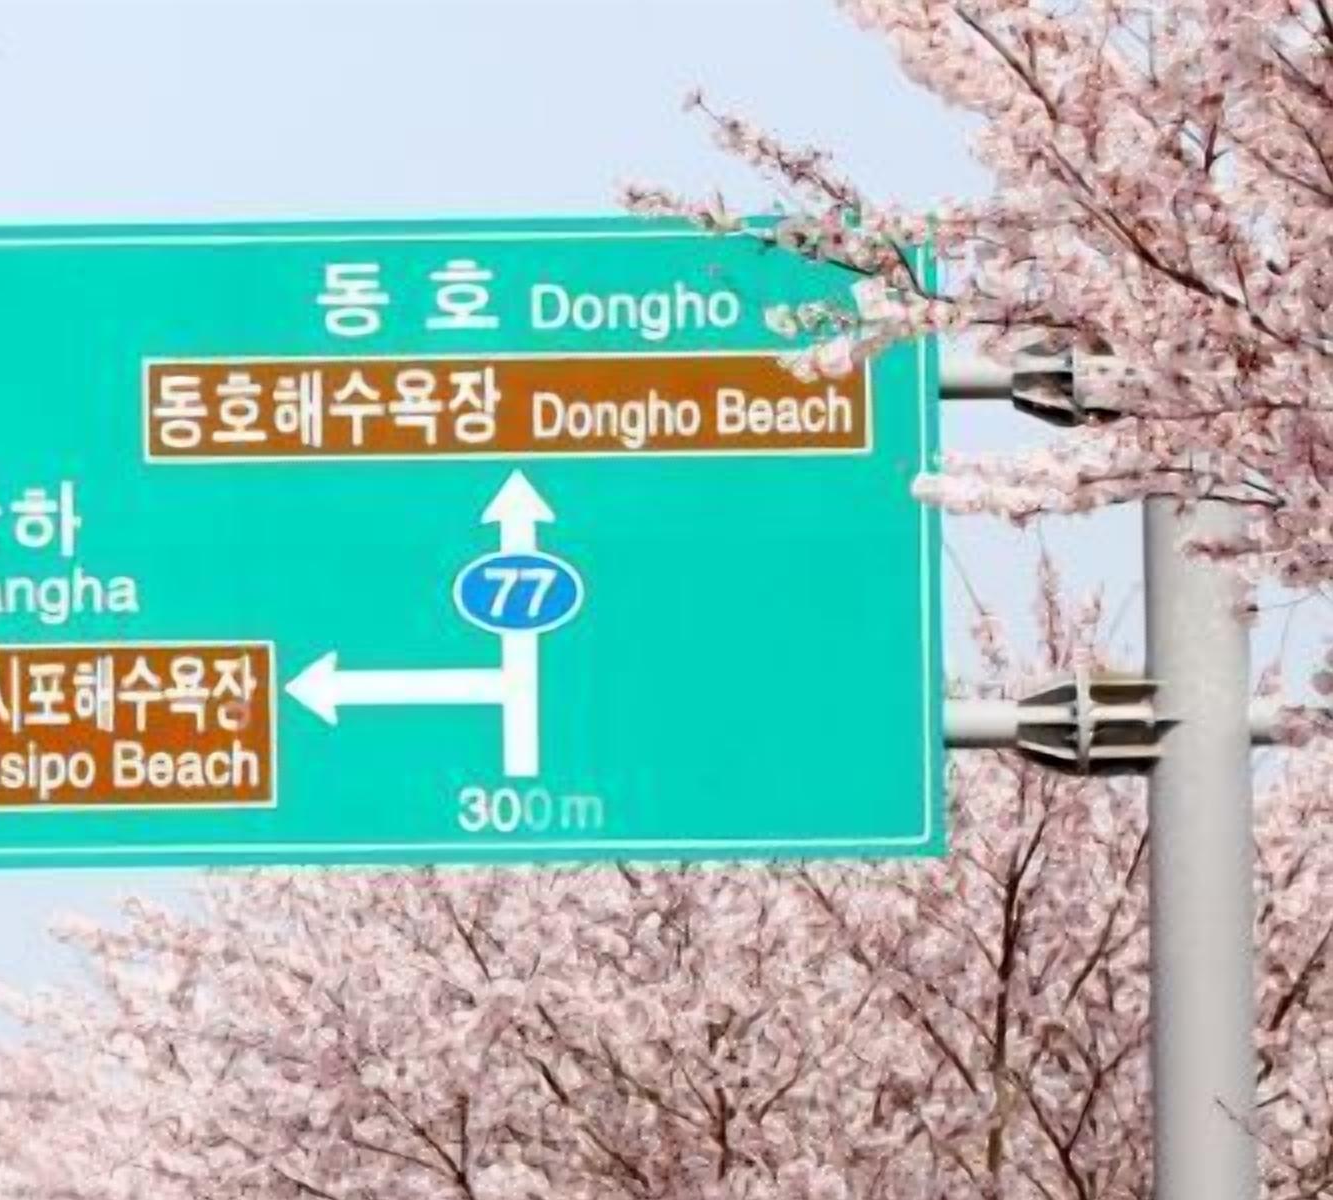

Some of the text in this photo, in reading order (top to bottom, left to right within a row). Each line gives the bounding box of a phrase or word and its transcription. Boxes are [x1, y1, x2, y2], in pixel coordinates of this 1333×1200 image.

[530, 282, 740, 341] Dongho
[151, 366, 854, 450] 동호해수욕장 Dongho Beach
[484, 567, 558, 617] 77
[112, 739, 260, 789] Beach
